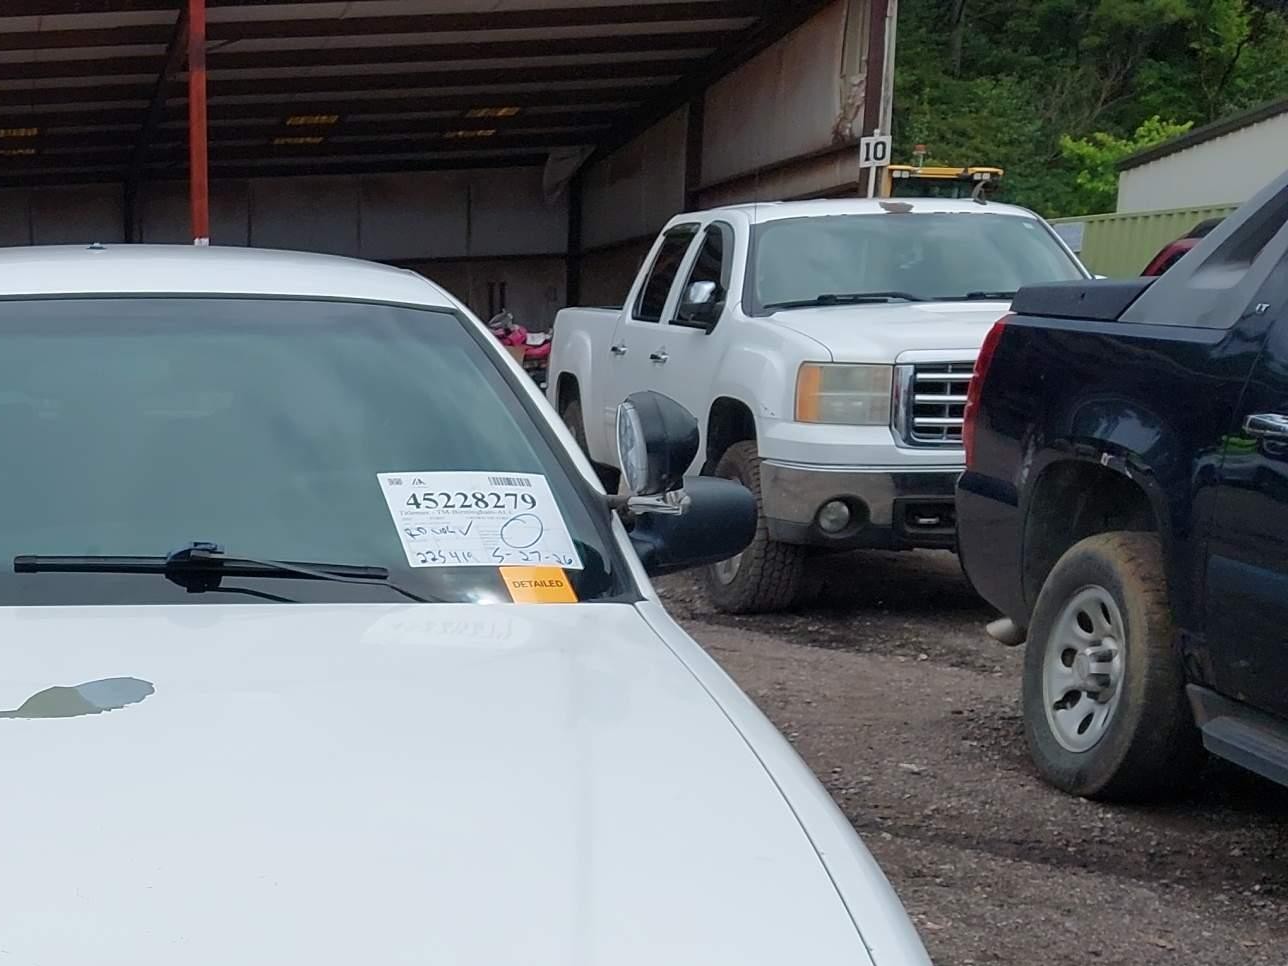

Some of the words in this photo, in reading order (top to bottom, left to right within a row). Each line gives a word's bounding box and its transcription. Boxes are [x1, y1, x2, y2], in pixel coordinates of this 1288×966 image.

[864, 140, 887, 162] 10
[406, 491, 537, 511] 45228279
[512, 580, 564, 588] DETAILED
